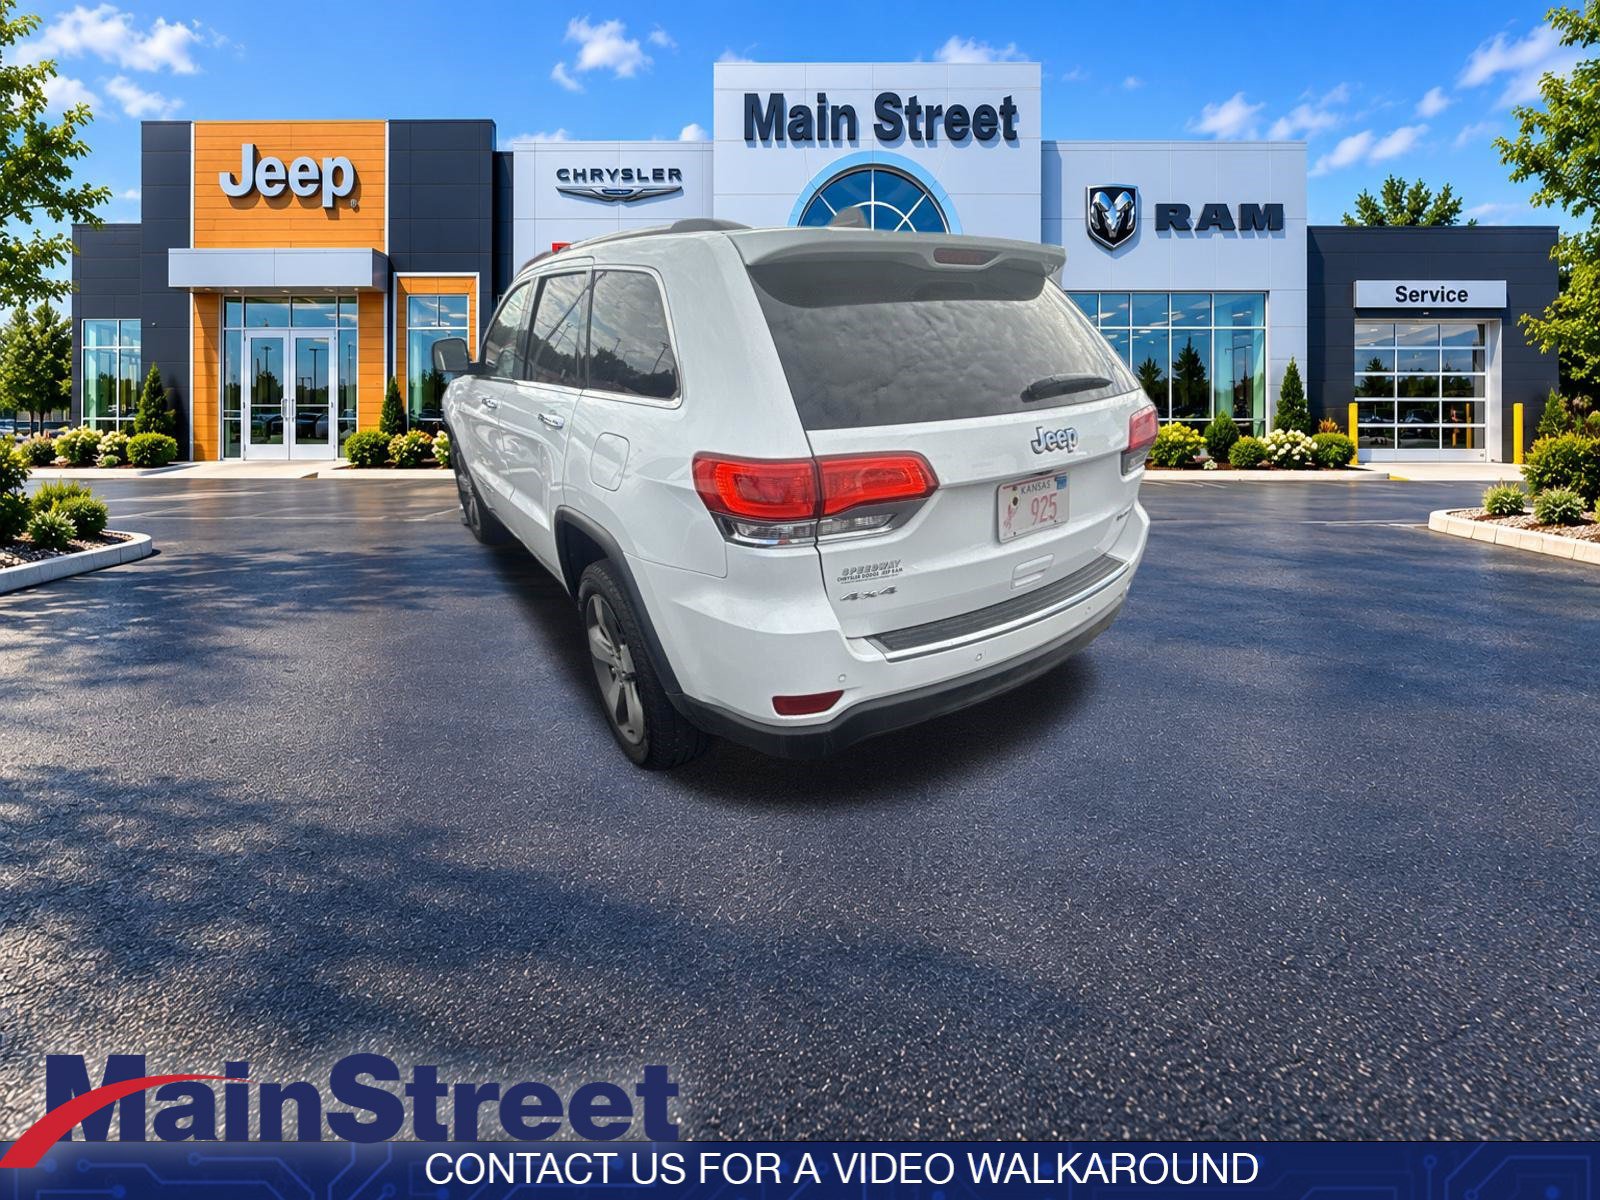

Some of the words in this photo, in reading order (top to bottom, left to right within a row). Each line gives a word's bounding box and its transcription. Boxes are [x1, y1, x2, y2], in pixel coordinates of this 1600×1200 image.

[744, 92, 857, 142] Main
[873, 91, 1017, 142] Street
[219, 143, 355, 209] Jeep
[556, 168, 683, 182] CHRYSLER
[1155, 203, 1284, 232] RAM
[1395, 285, 1469, 303] Service
[1031, 426, 1079, 455] Jeep
[1020, 479, 1051, 495] KANSAS
[1030, 492, 1058, 526] 925
[842, 559, 902, 576] SPEEDWAY
